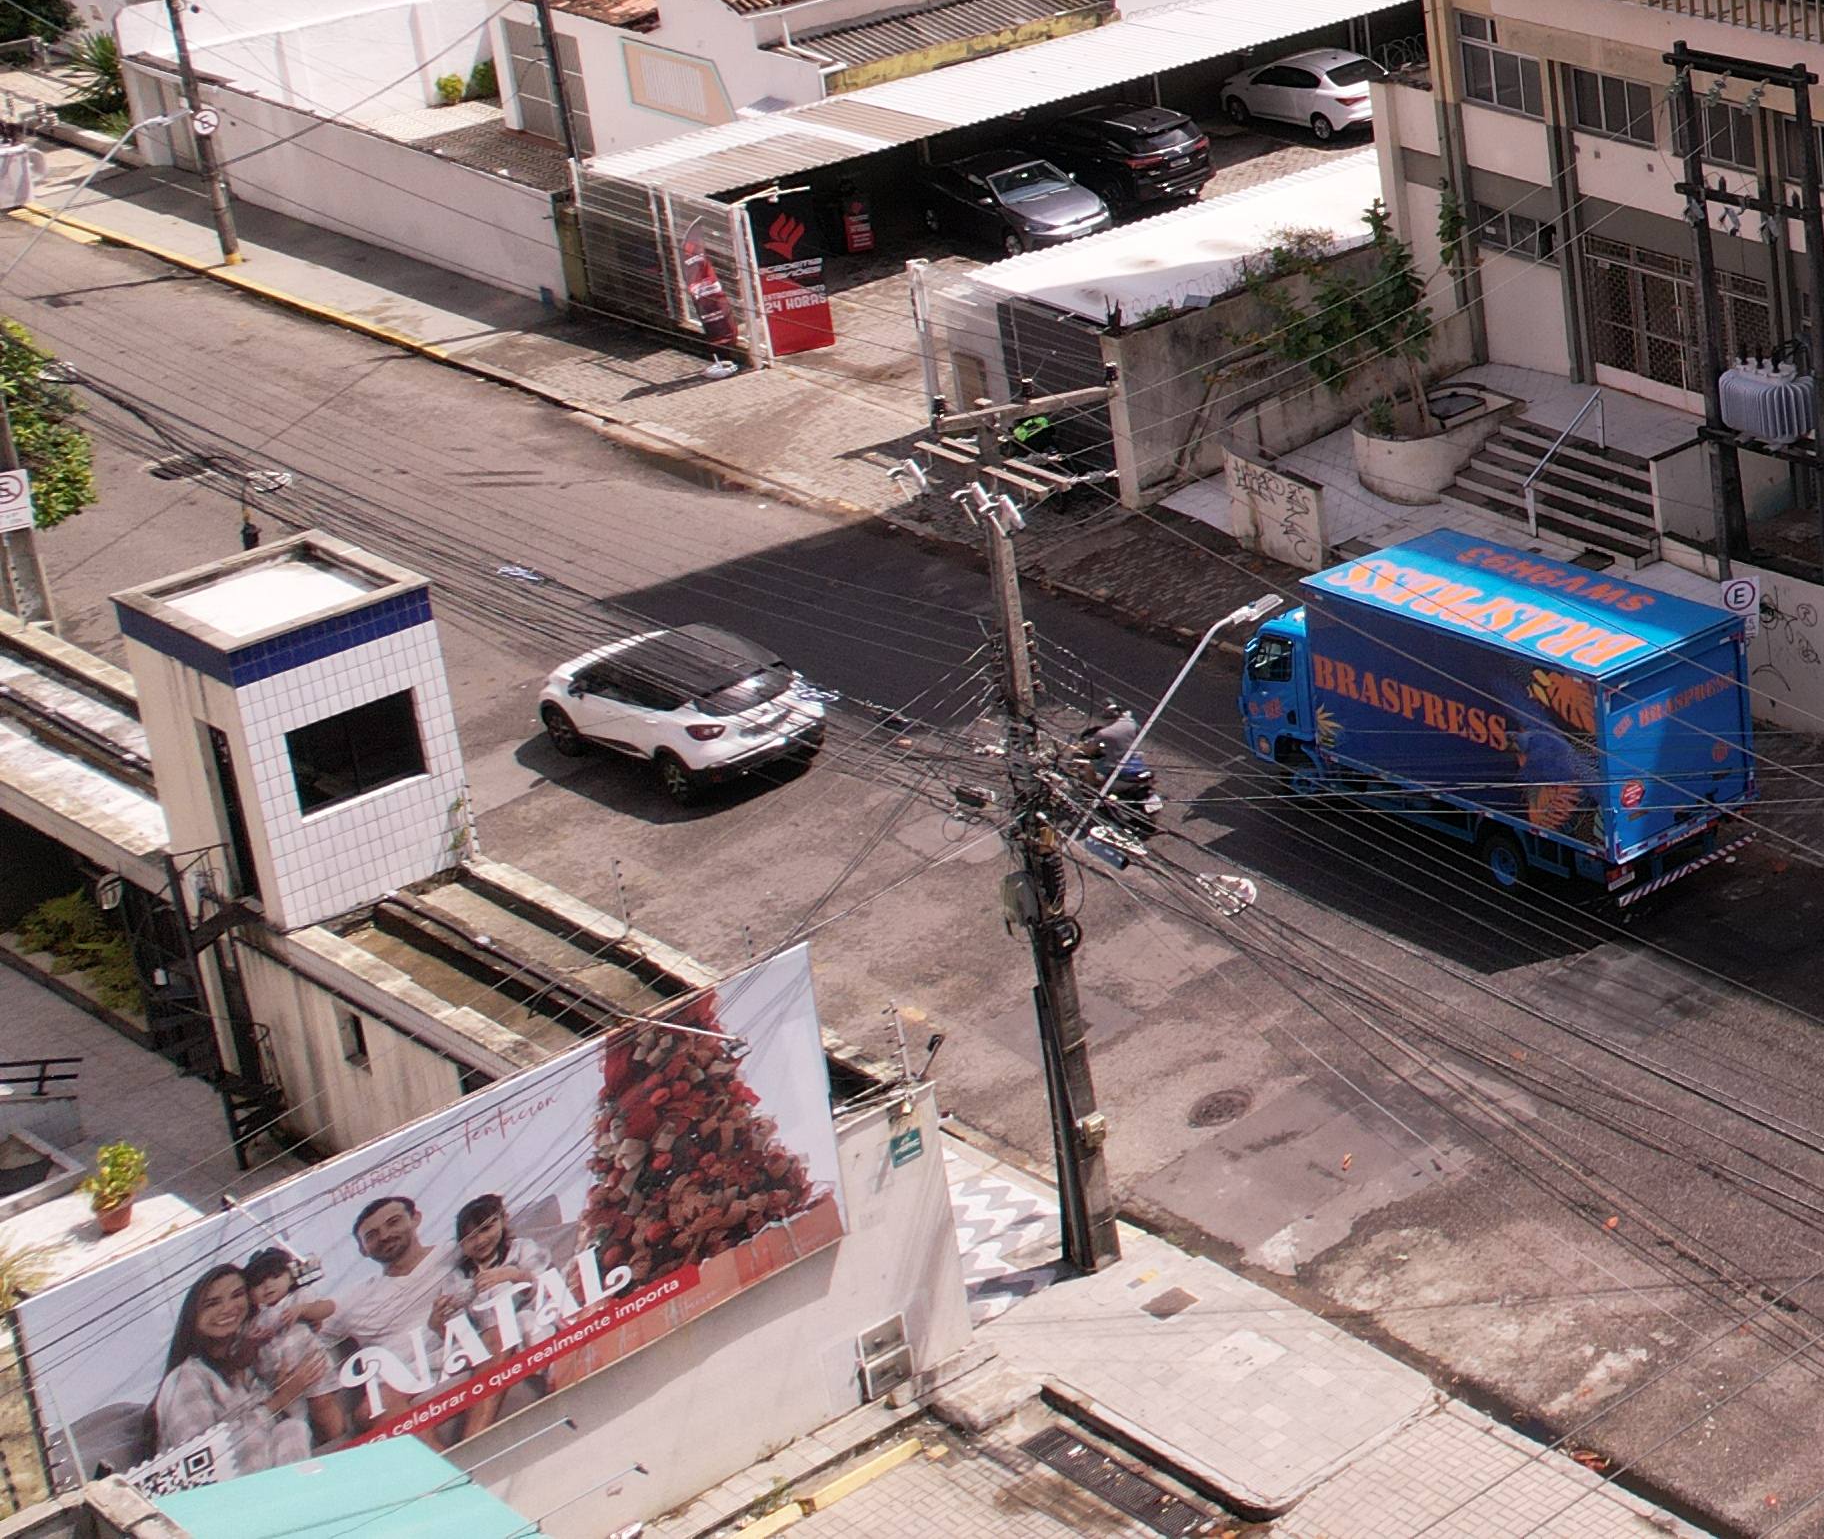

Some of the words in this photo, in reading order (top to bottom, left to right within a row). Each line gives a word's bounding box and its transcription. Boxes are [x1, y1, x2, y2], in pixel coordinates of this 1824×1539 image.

[764, 297, 783, 314] 24
[786, 293, 827, 311] HORAS
[1325, 559, 1649, 668] BRASPRESS
[1733, 587, 1745, 605] E
[1311, 653, 1507, 752] BRASPRESS
[338, 1244, 633, 1420] NATAL
[392, 1391, 468, 1436] celebrar
[471, 1383, 485, 1396] o
[489, 1362, 523, 1389] que
[526, 1315, 611, 1366] realmente
[615, 1278, 680, 1323] importa
